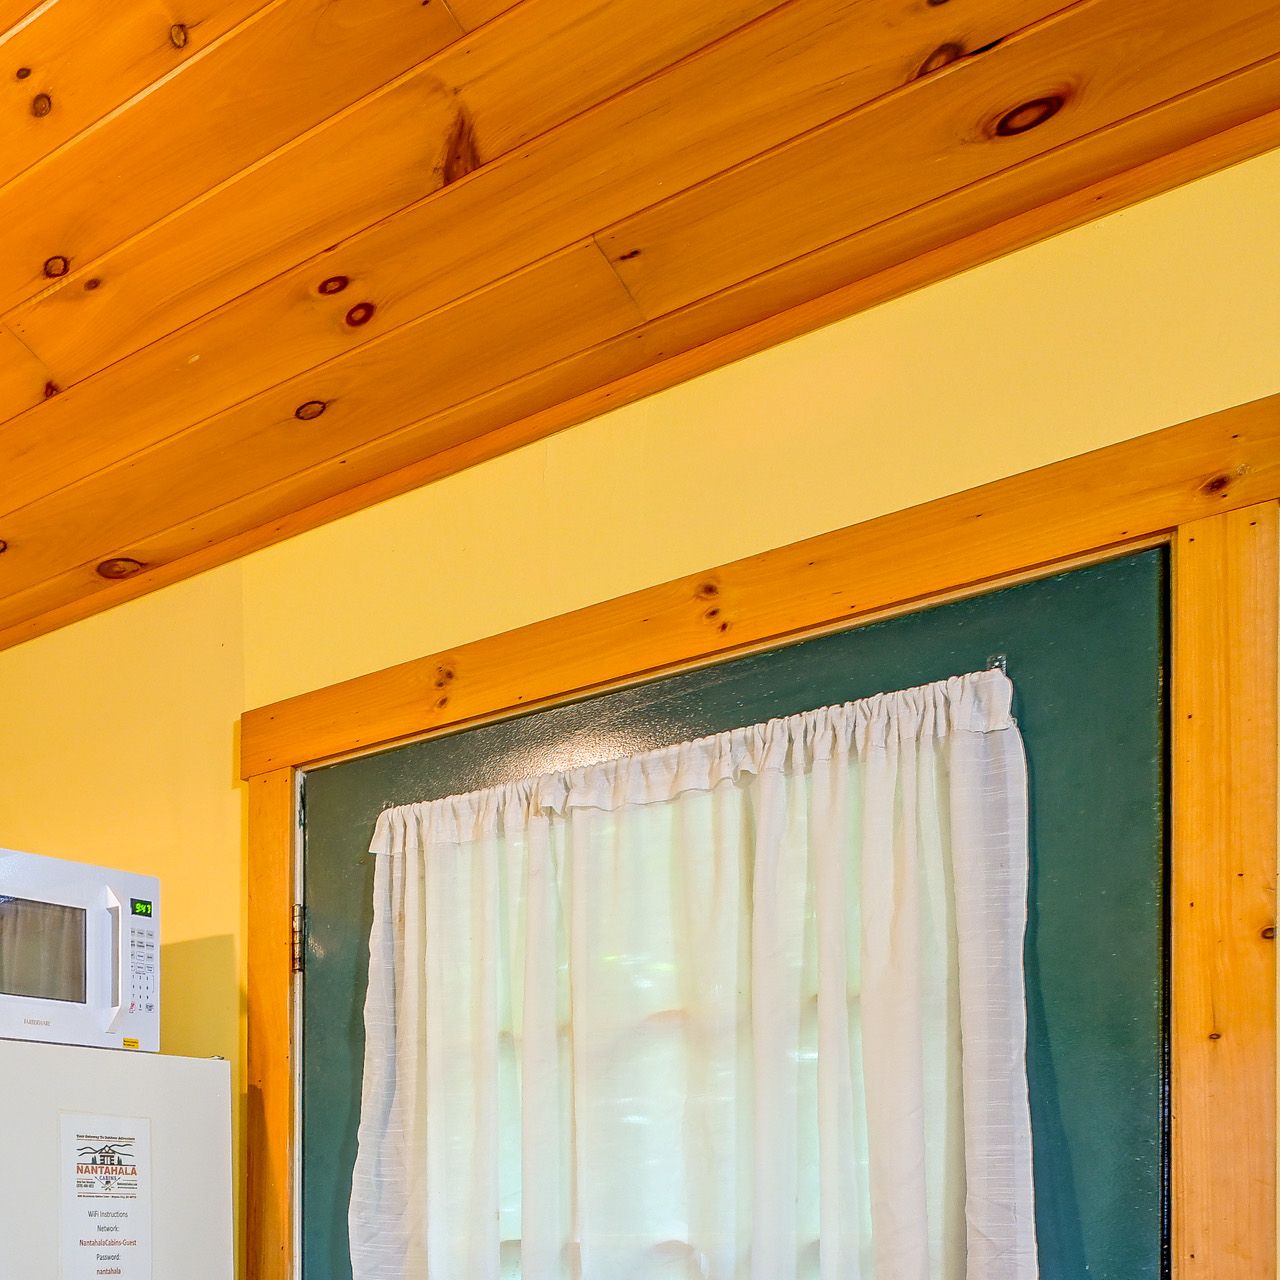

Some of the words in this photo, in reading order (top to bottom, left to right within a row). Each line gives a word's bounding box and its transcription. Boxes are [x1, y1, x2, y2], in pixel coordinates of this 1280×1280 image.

[76, 1165, 138, 1176] NANTAHALA
[88, 1210, 99, 1218] WiFi
[100, 1210, 128, 1218] Instructions
[96, 1267, 121, 1275] nantahala
